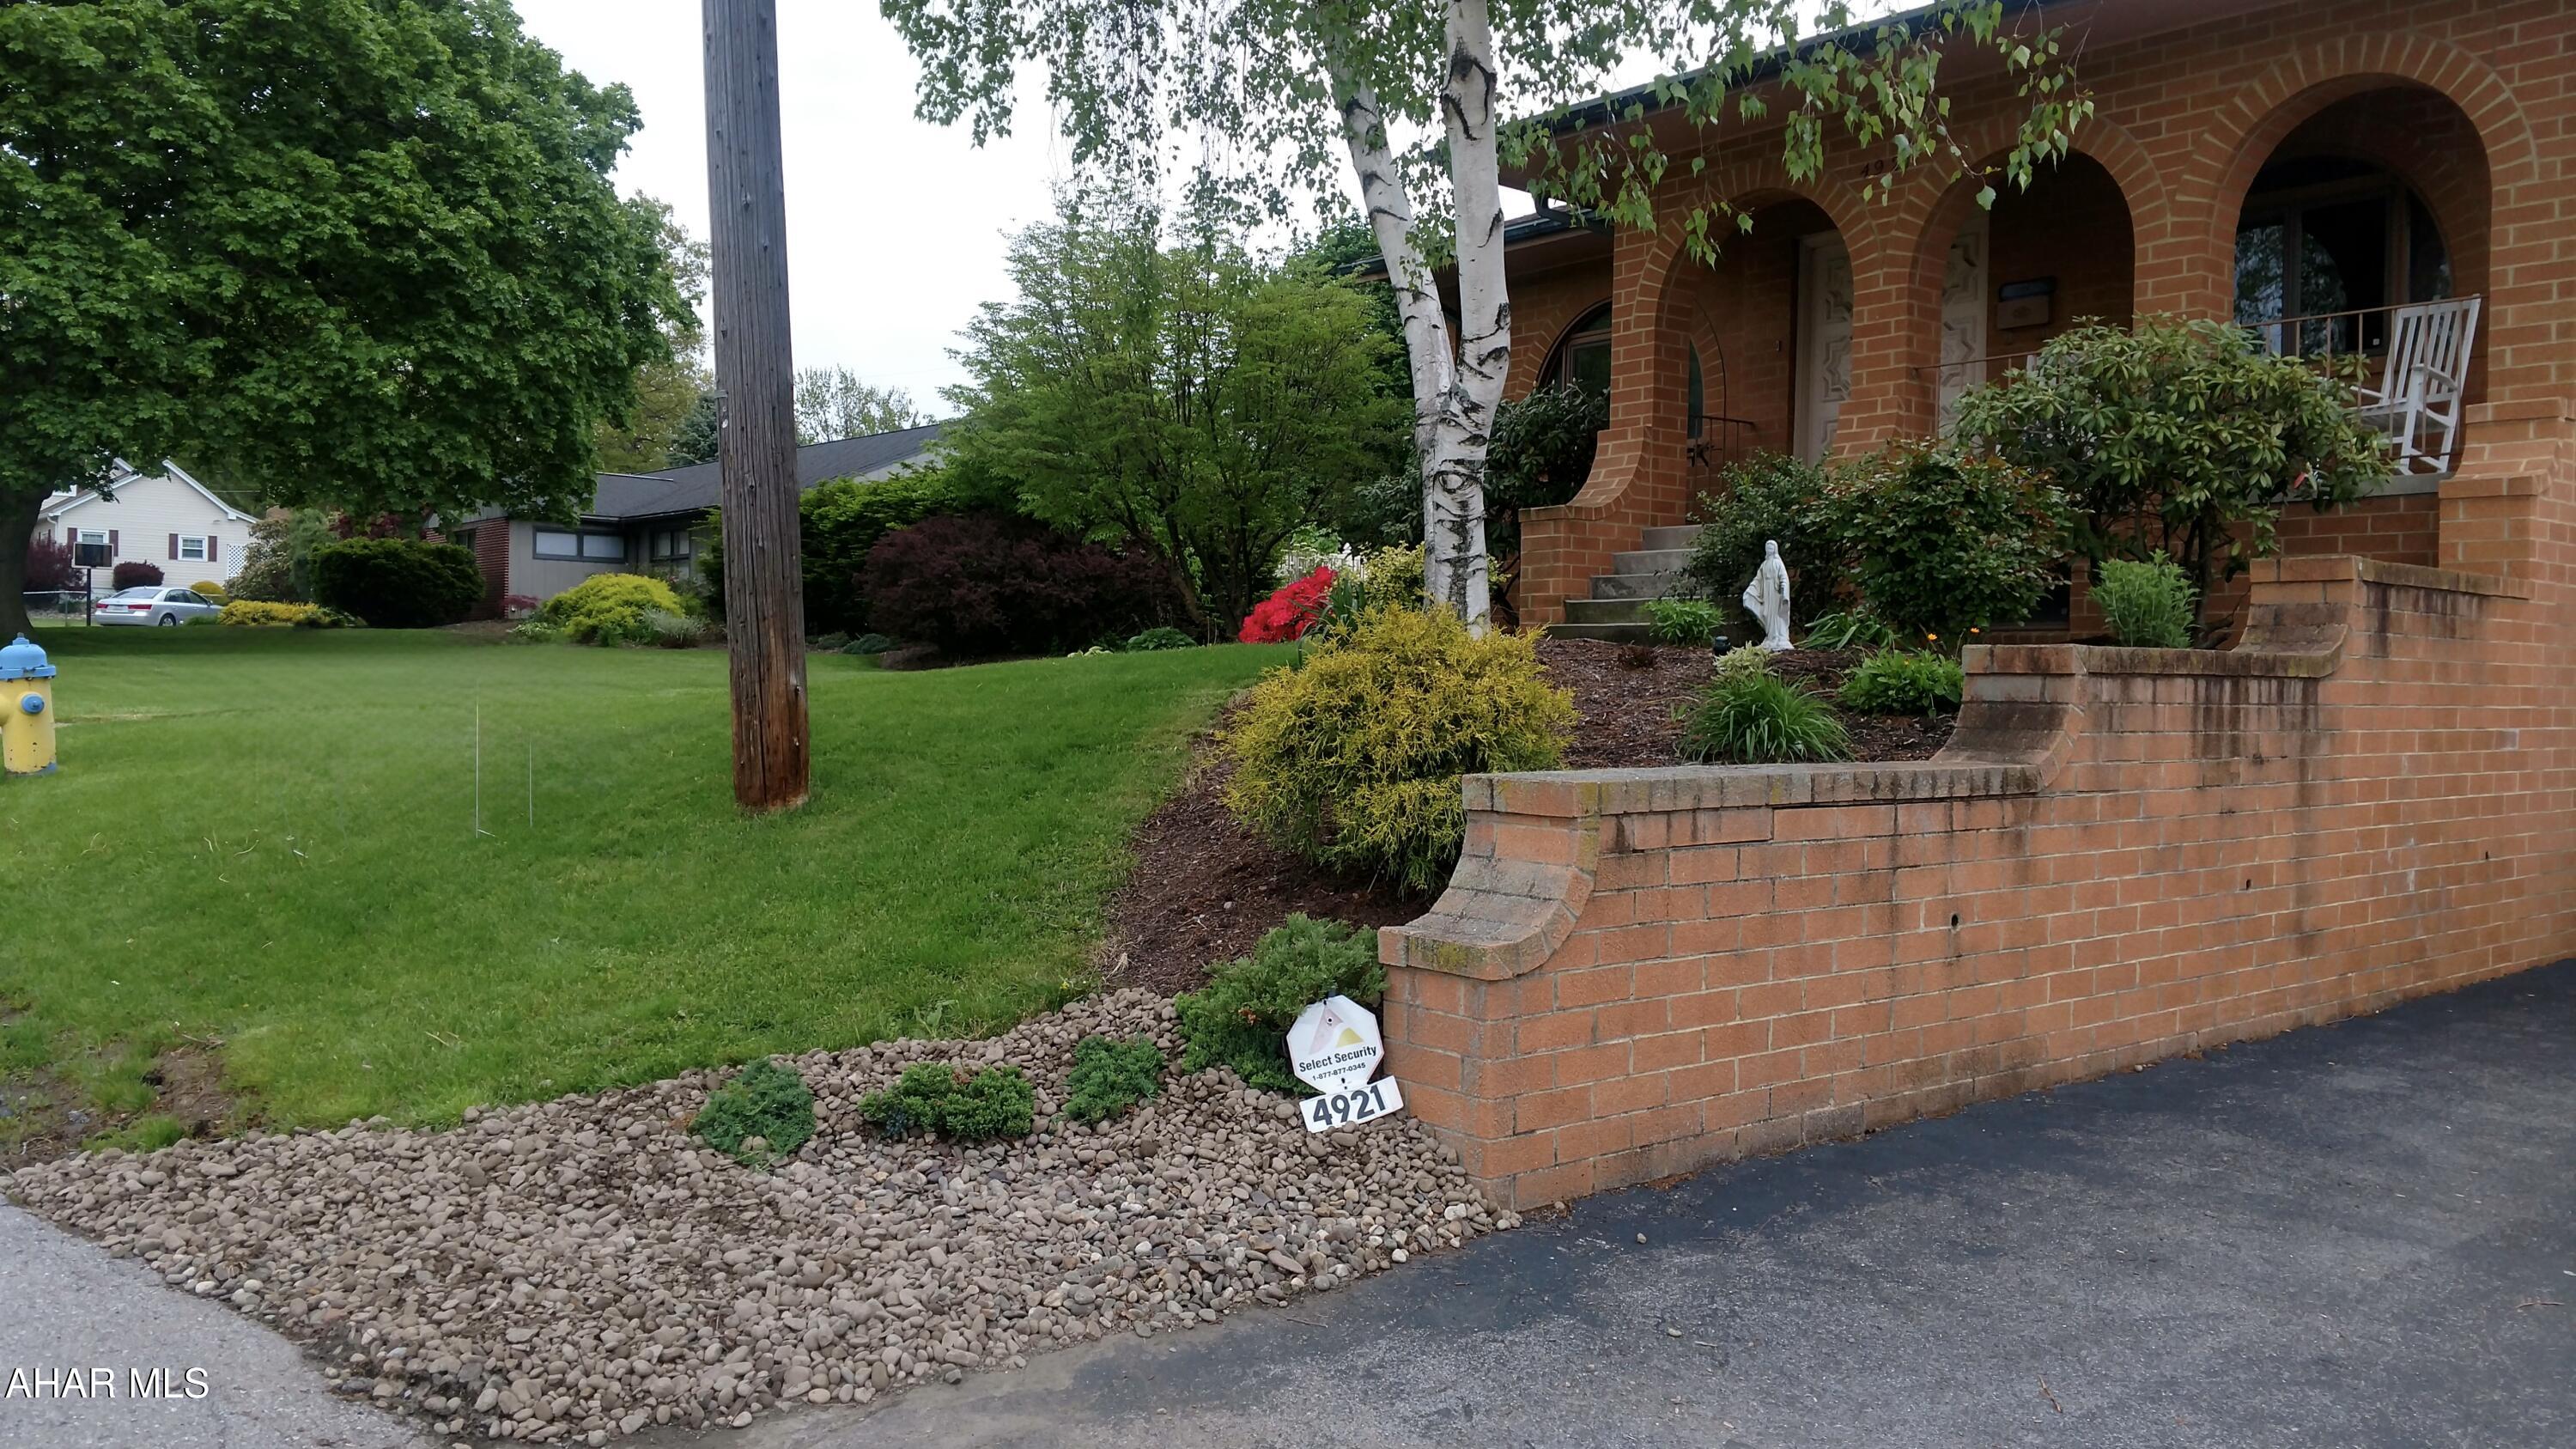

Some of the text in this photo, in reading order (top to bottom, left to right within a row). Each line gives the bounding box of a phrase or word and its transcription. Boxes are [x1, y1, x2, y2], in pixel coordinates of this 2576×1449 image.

[1299, 1045, 1376, 1073] Select Security
[1312, 1062, 1366, 1081] 1-877-877-0345
[1312, 1085, 1387, 1126] 4921
